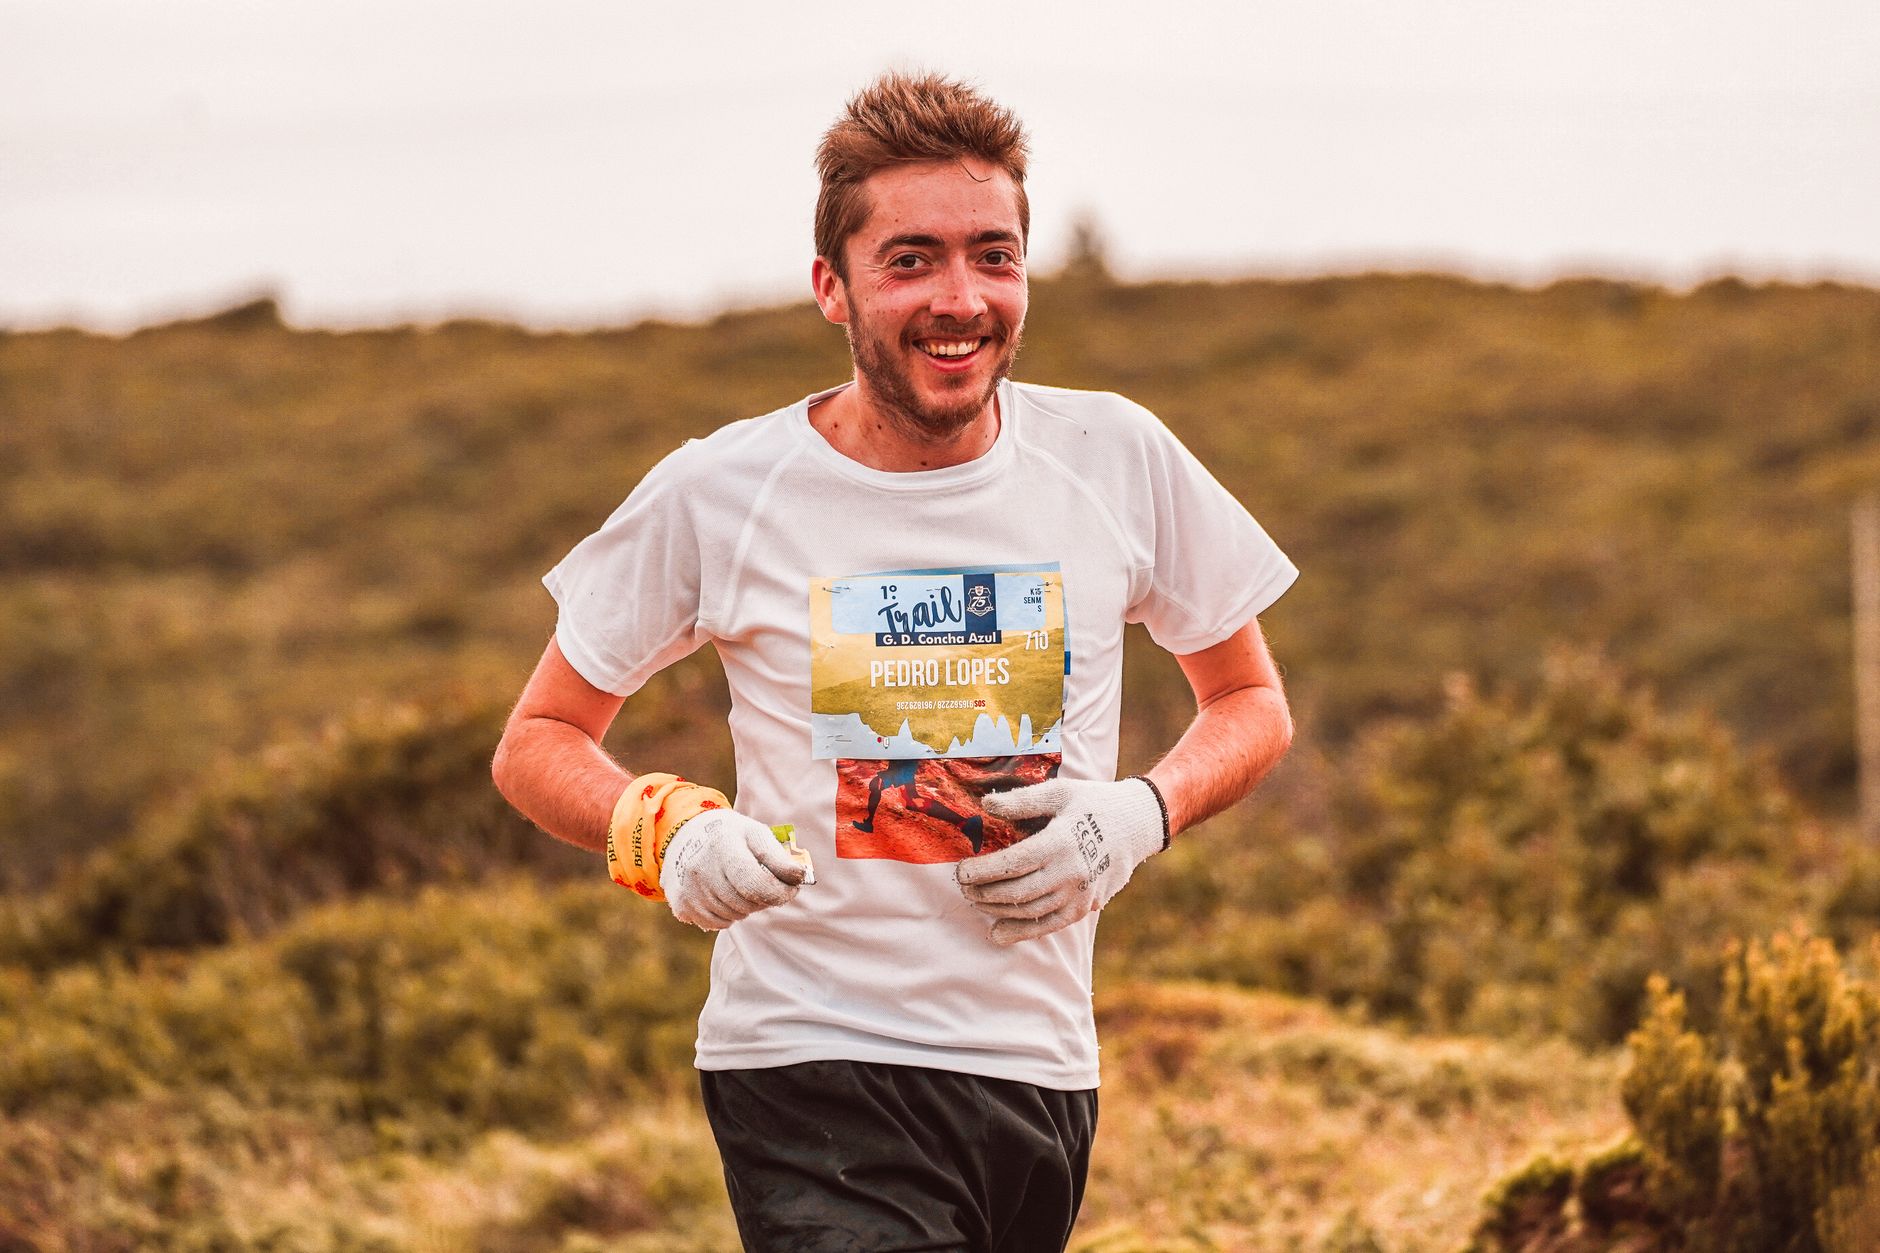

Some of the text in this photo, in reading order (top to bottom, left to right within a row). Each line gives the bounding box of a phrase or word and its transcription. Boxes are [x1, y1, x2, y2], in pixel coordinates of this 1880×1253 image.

[878, 586, 962, 633] Trail
[971, 597, 986, 607] 75
[918, 633, 964, 644] Concha
[968, 632, 996, 643] Azul
[1024, 631, 1049, 650] 710
[870, 658, 1010, 688] PEDRO LOPES
